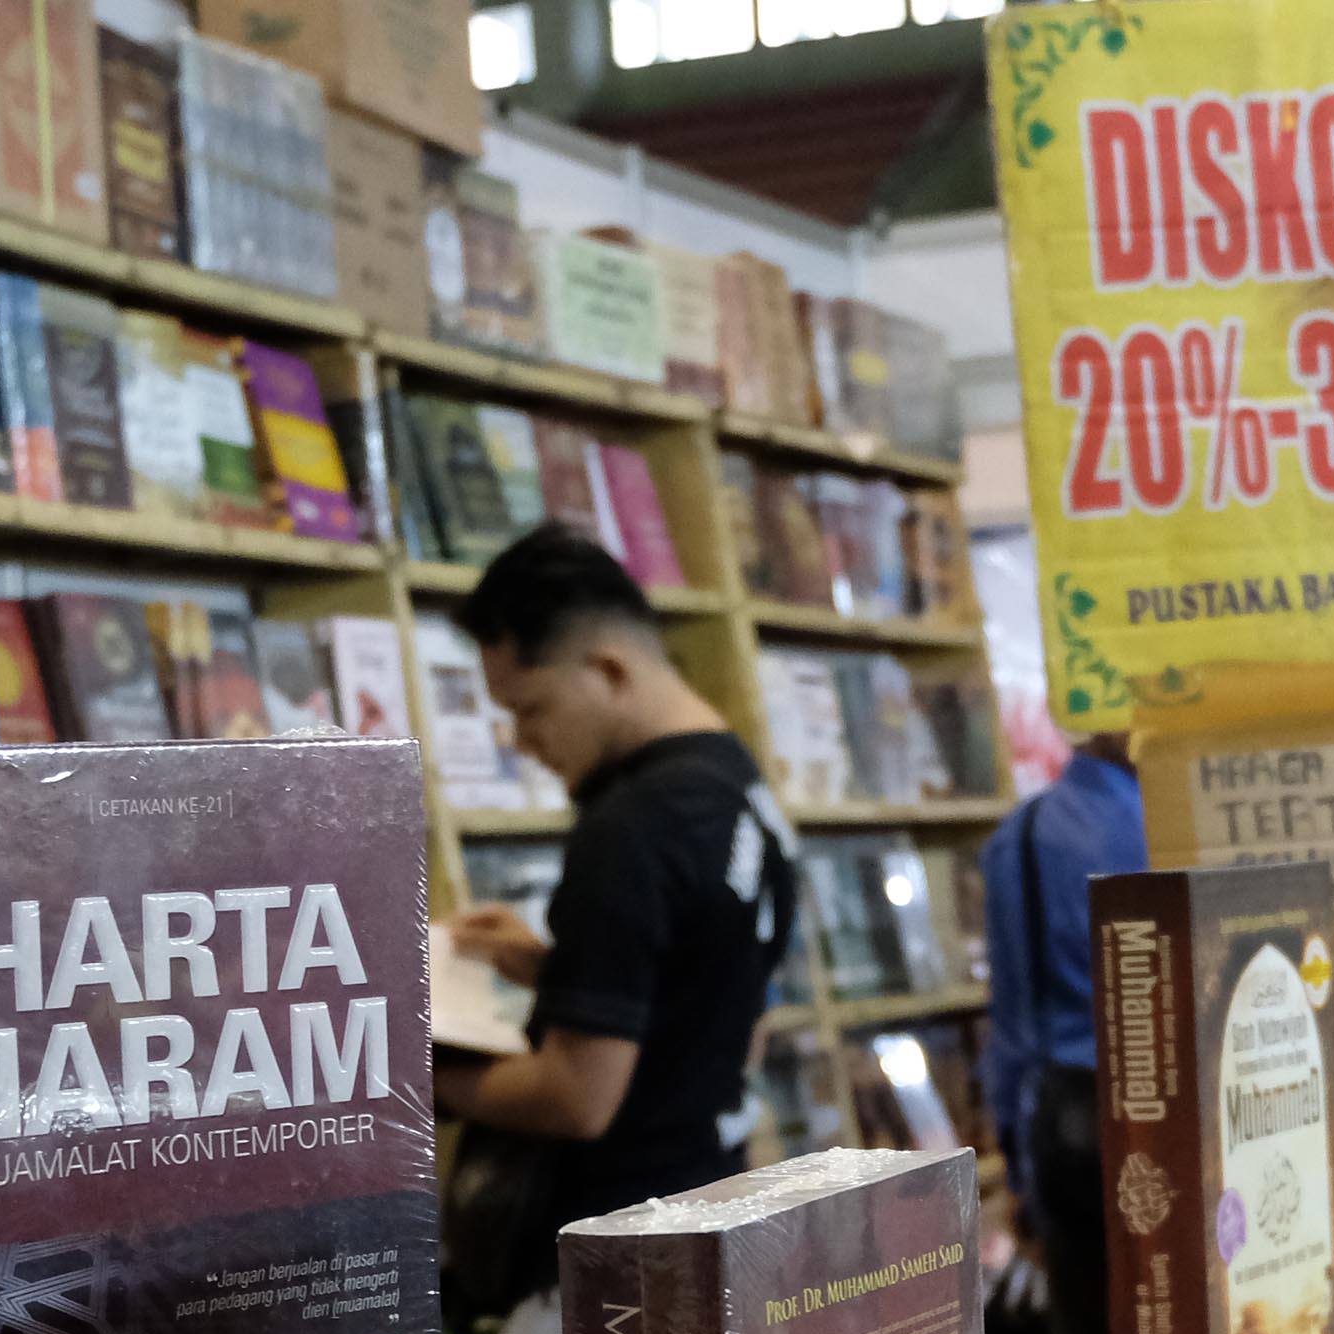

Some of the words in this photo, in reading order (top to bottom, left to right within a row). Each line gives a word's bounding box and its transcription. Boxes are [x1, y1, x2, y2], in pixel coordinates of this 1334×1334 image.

[1126, 576, 1294, 625] PUSTAKA
[98, 798, 177, 818] CETAKAN
[179, 796, 223, 815] KE-21
[150, 1113, 376, 1168] KONTEMPORER
[268, 1257, 327, 1282] berjualan
[330, 1253, 343, 1272] di
[344, 1250, 380, 1272] pasar
[381, 1244, 399, 1264] ini
[766, 1295, 801, 1327] PROF.
[827, 1264, 899, 1305] MUHAMMAD
[901, 1250, 938, 1281] SAMEH
[939, 1242, 964, 1267] SAID
[175, 1300, 206, 1320] para
[208, 1290, 274, 1316] pedagang
[276, 1283, 307, 1305] yang
[310, 1277, 341, 1297] tidak
[343, 1266, 399, 1293] mengerti
[302, 1300, 330, 1320] dien
